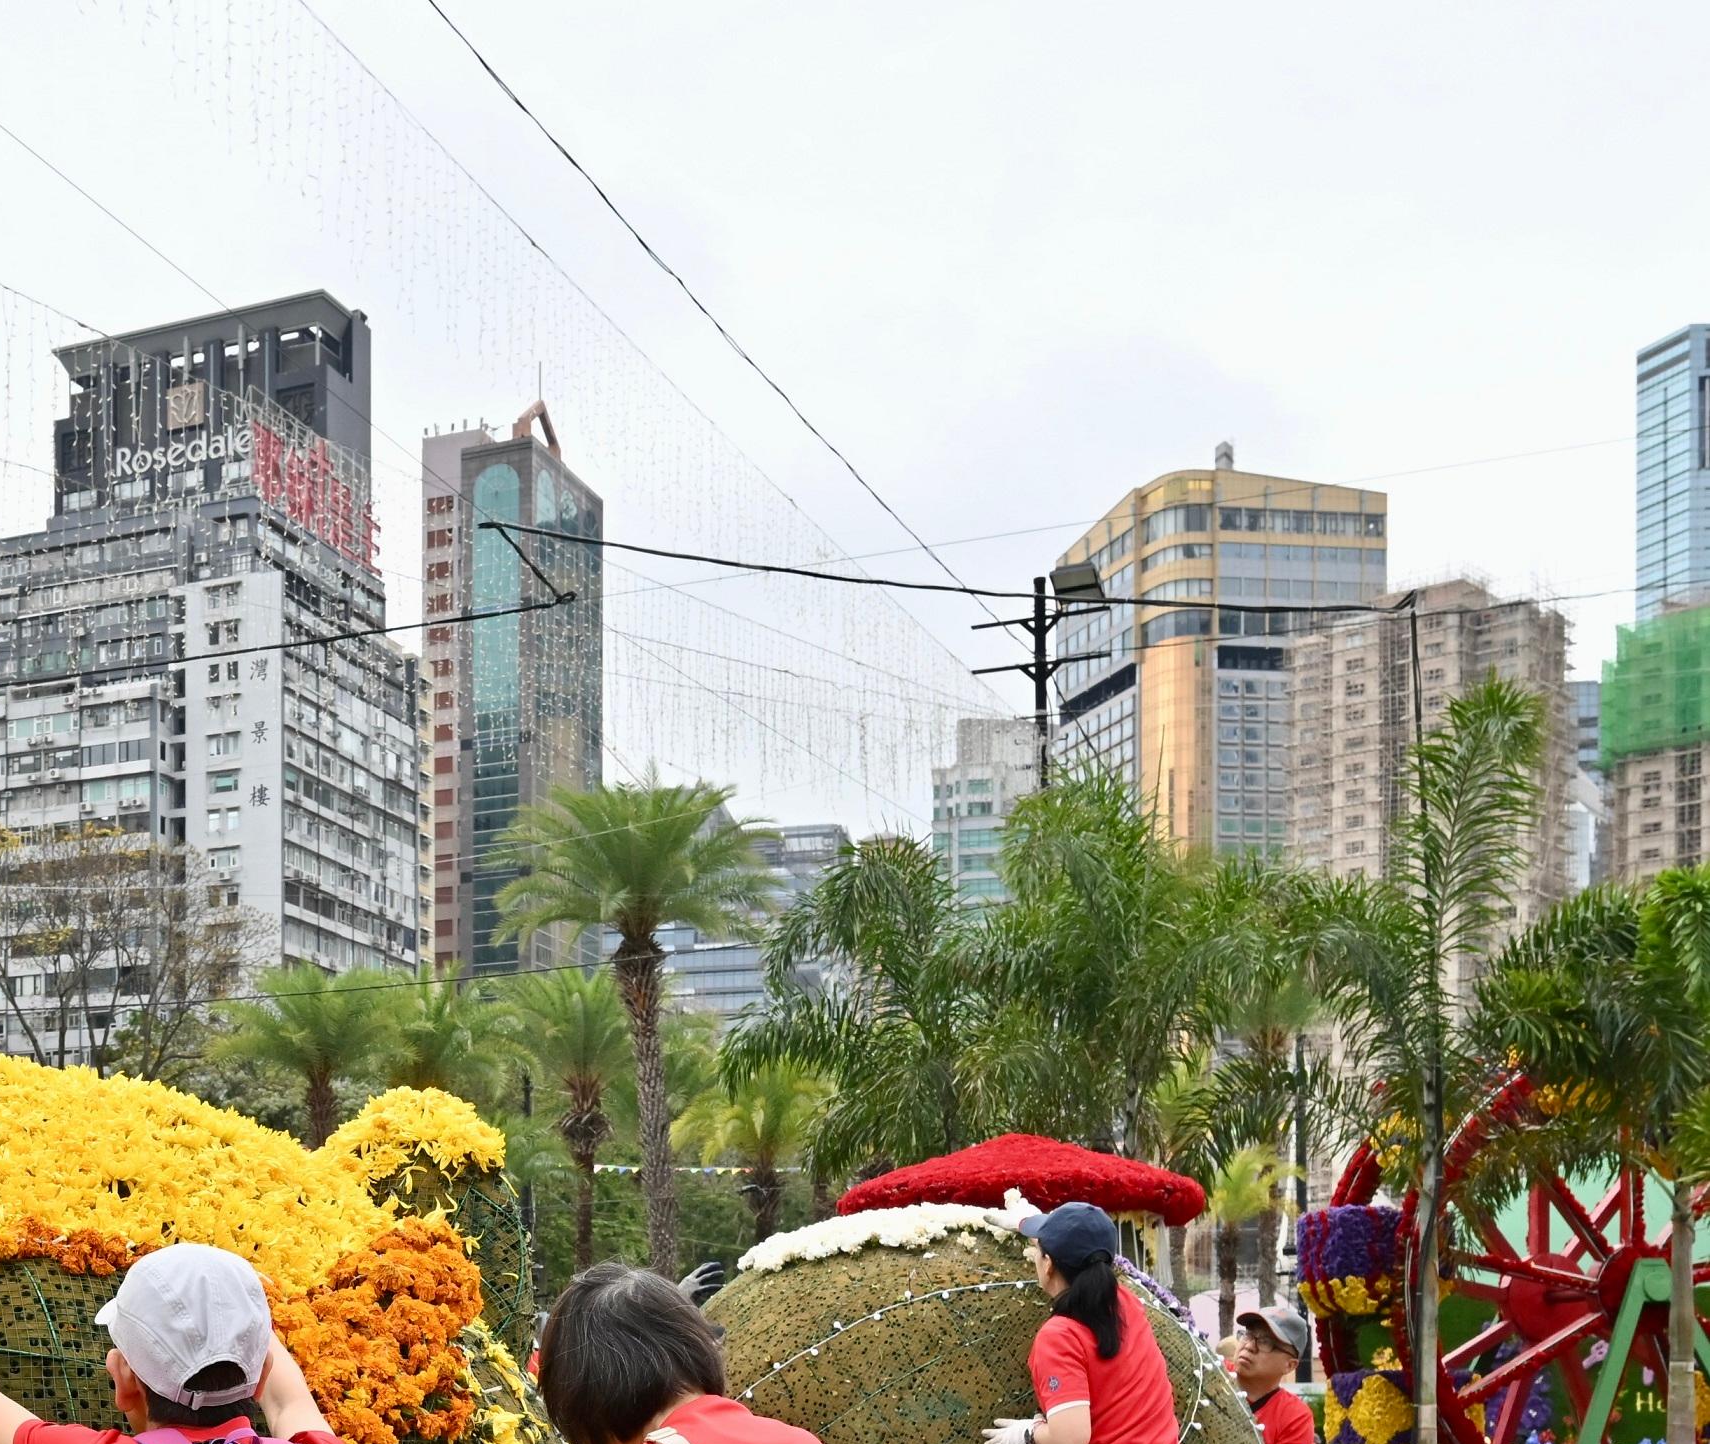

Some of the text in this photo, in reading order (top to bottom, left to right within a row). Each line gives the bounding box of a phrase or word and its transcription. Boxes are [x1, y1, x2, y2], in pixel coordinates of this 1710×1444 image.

[116, 425, 254, 477] Rosedale
[250, 658, 271, 807] 灣景樓
